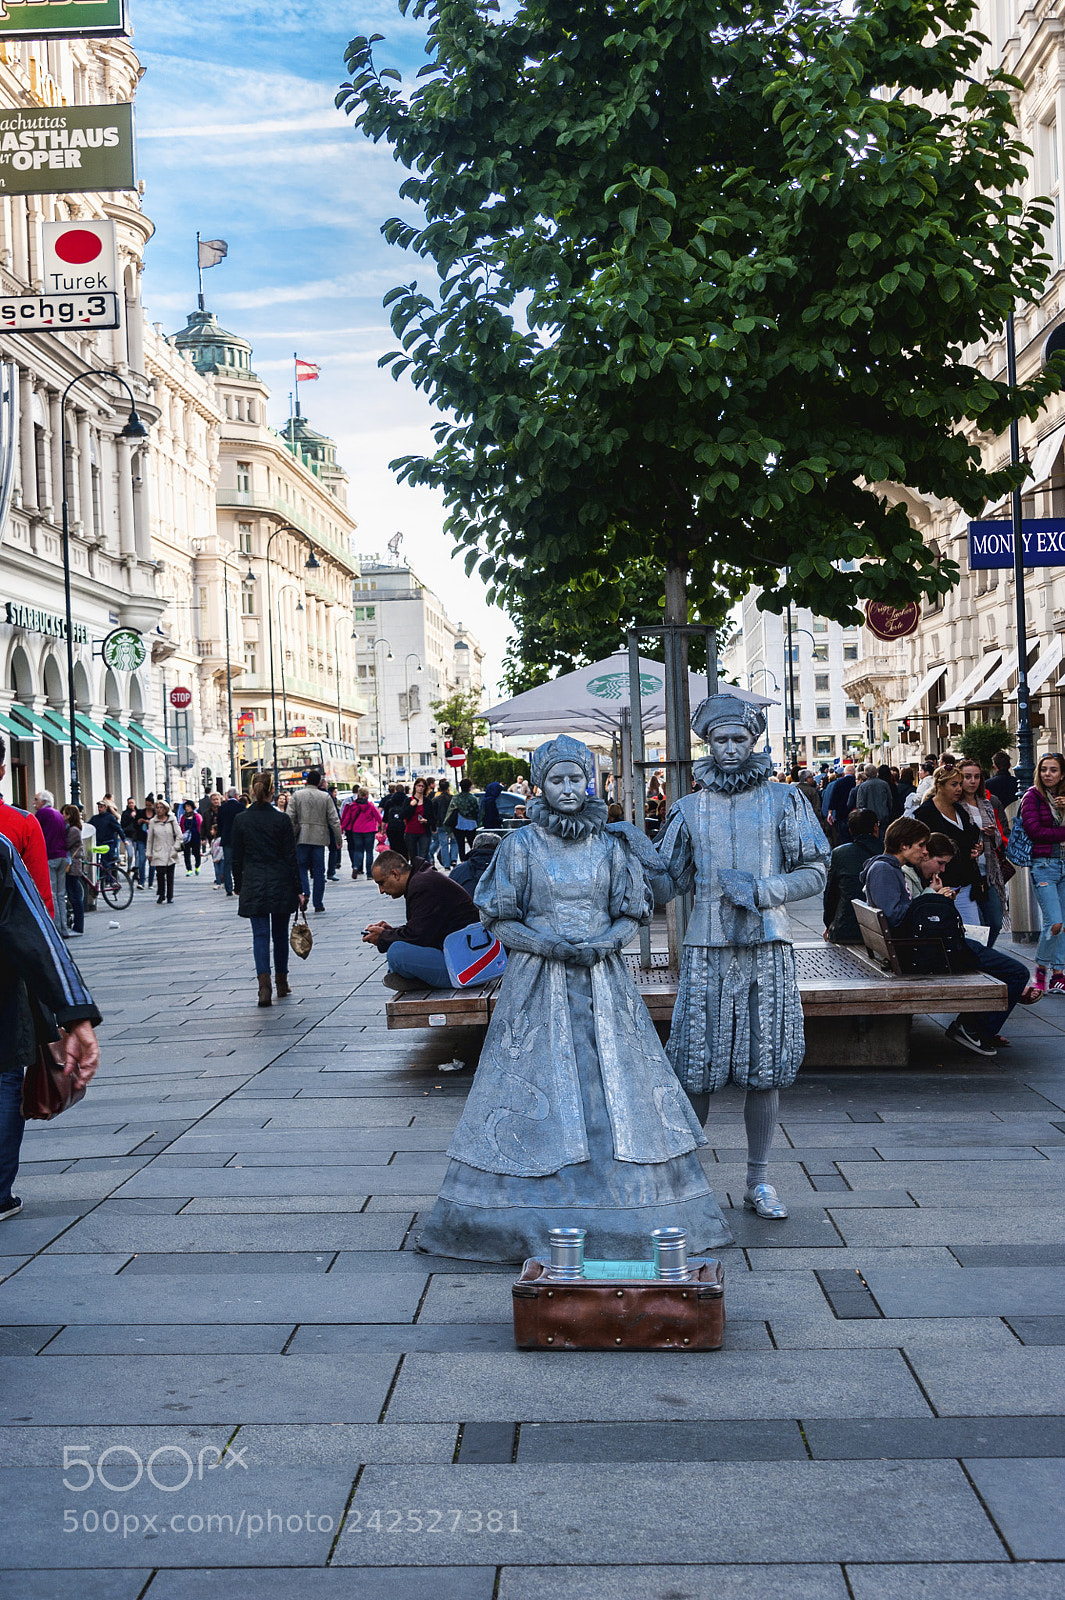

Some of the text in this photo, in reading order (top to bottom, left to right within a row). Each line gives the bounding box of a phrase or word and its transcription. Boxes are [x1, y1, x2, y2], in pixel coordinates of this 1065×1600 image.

[0, 127, 120, 151] ASTHAUS
[12, 149, 82, 171] OPER
[50, 272, 108, 290] Turek
[5, 602, 62, 637] STARBUCKS
[171, 692, 191, 703] STOP
